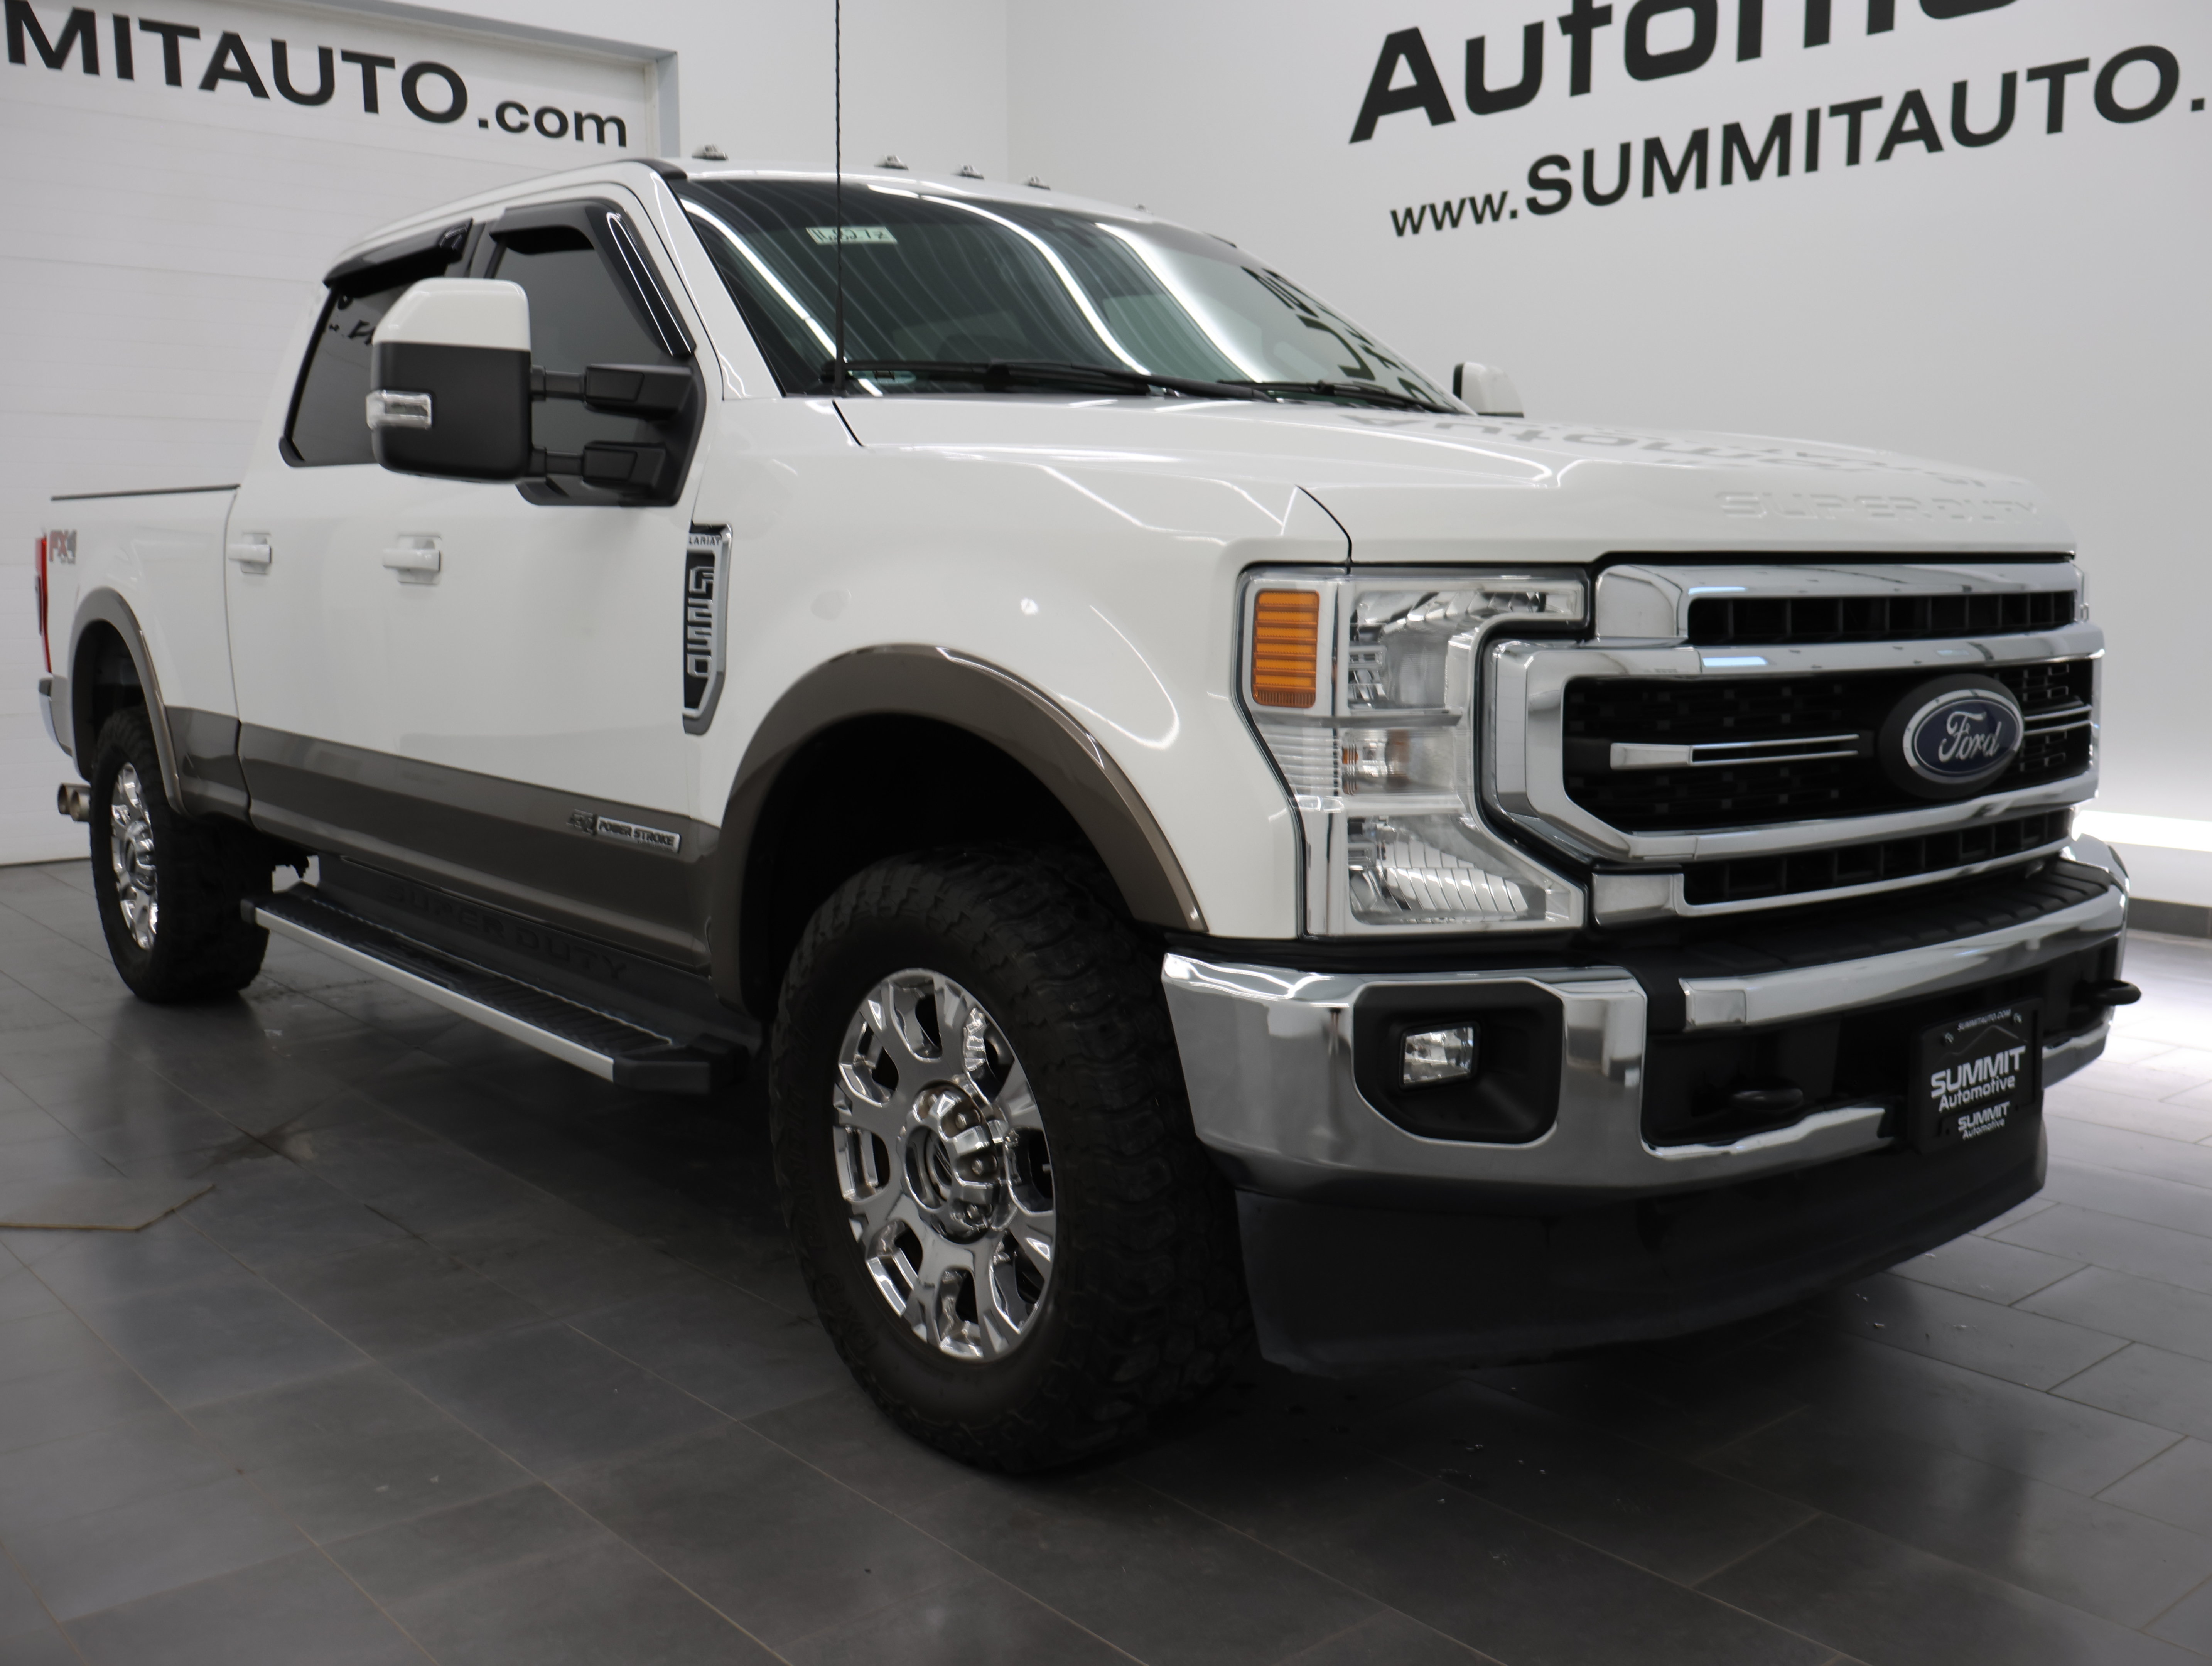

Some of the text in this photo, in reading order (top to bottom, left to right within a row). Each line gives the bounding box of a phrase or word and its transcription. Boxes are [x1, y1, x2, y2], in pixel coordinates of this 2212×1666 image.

[4, 0, 628, 148] MITAUTO.com
[689, 536, 722, 545] LARIAT
[1938, 711, 2002, 763] Ford
[633, 827, 675, 846] STROKE
[1930, 1045, 2026, 1099] SUMMIT
[1938, 1075, 2016, 1113] Automotive
[1957, 1101, 2011, 1132] SUMMIT
[1962, 1118, 2005, 1141] Automotive
